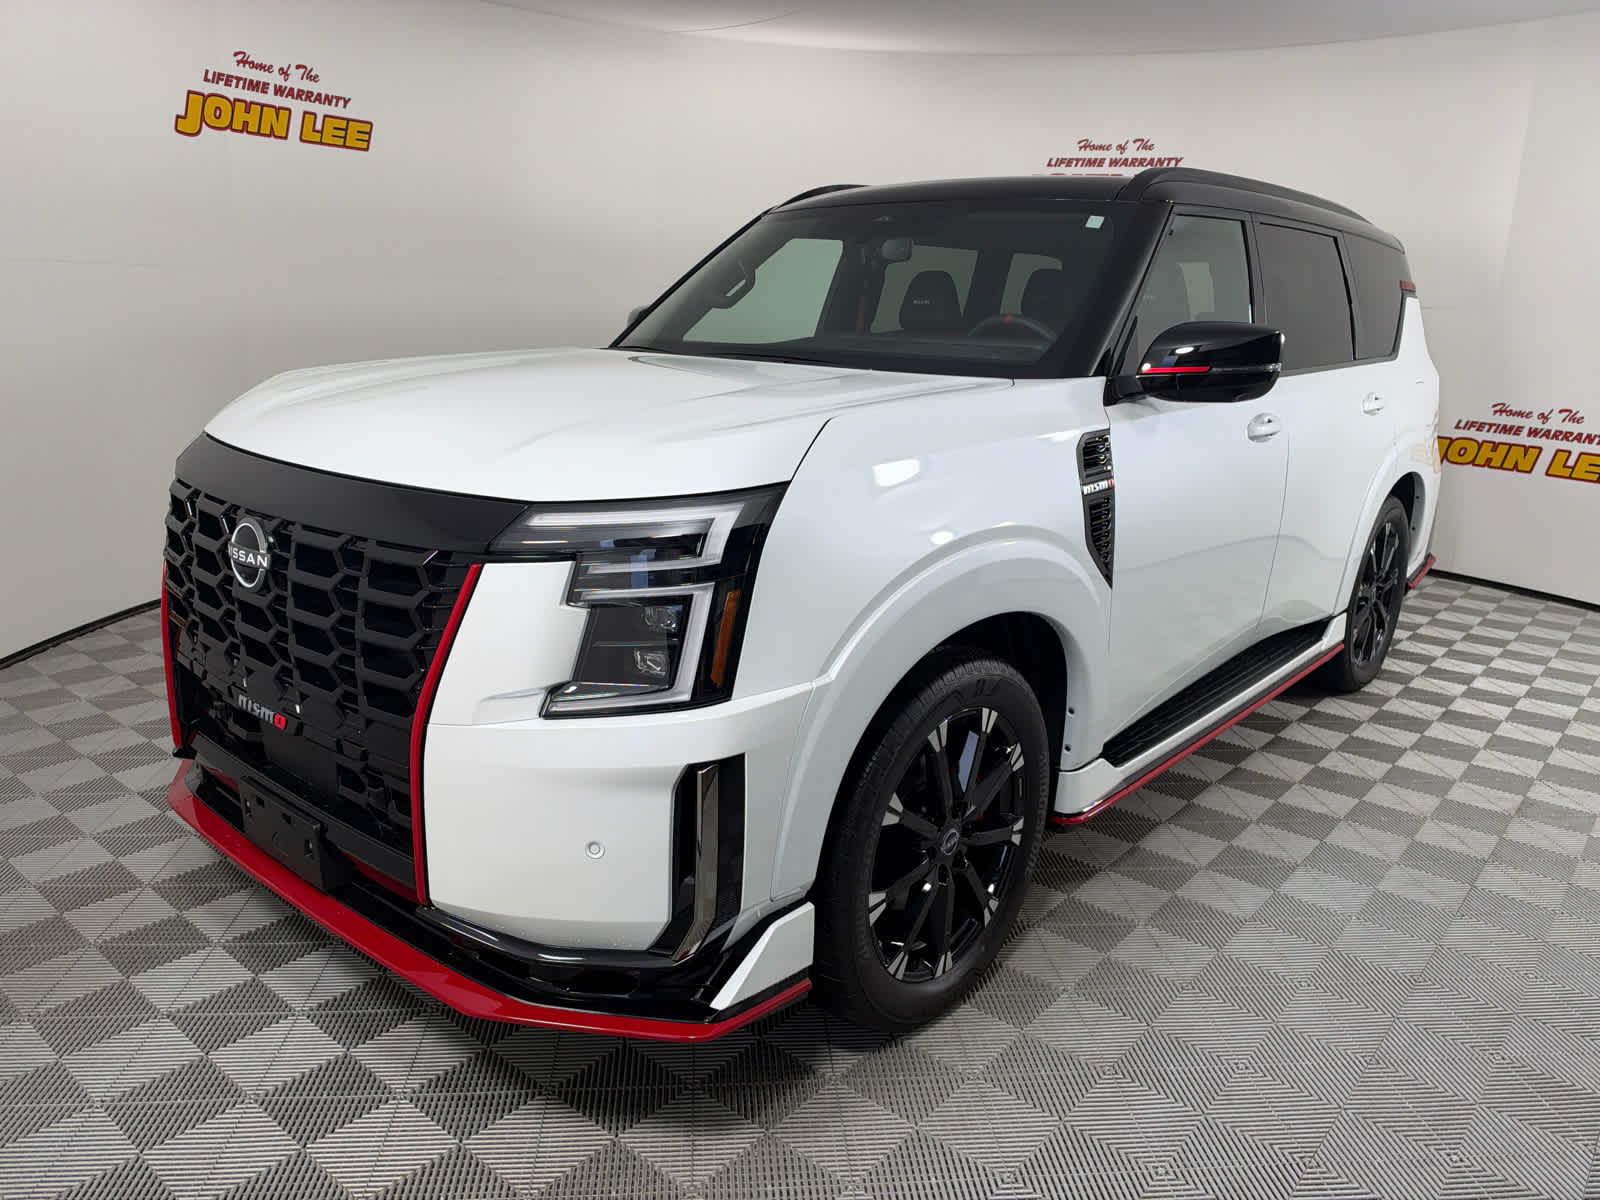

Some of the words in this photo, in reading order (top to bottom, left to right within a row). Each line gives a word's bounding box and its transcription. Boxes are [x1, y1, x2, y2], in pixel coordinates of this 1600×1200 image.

[233, 51, 274, 74] Home
[278, 64, 292, 82] of
[295, 64, 320, 83] The
[203, 69, 270, 95] LIFETIME
[273, 83, 351, 109] WARRANTY
[174, 89, 292, 140] JOHN
[299, 111, 373, 152] LEE
[1077, 138, 1112, 152] Home
[1115, 140, 1129, 155] of
[1133, 138, 1155, 152] The
[1046, 157, 1105, 168] LIFETIME
[1108, 157, 1184, 168] WARRANTY
[1491, 402, 1533, 420] Home
[1537, 409, 1553, 425] of
[1558, 408, 1585, 424] The
[1454, 419, 1524, 437] LIFETIME
